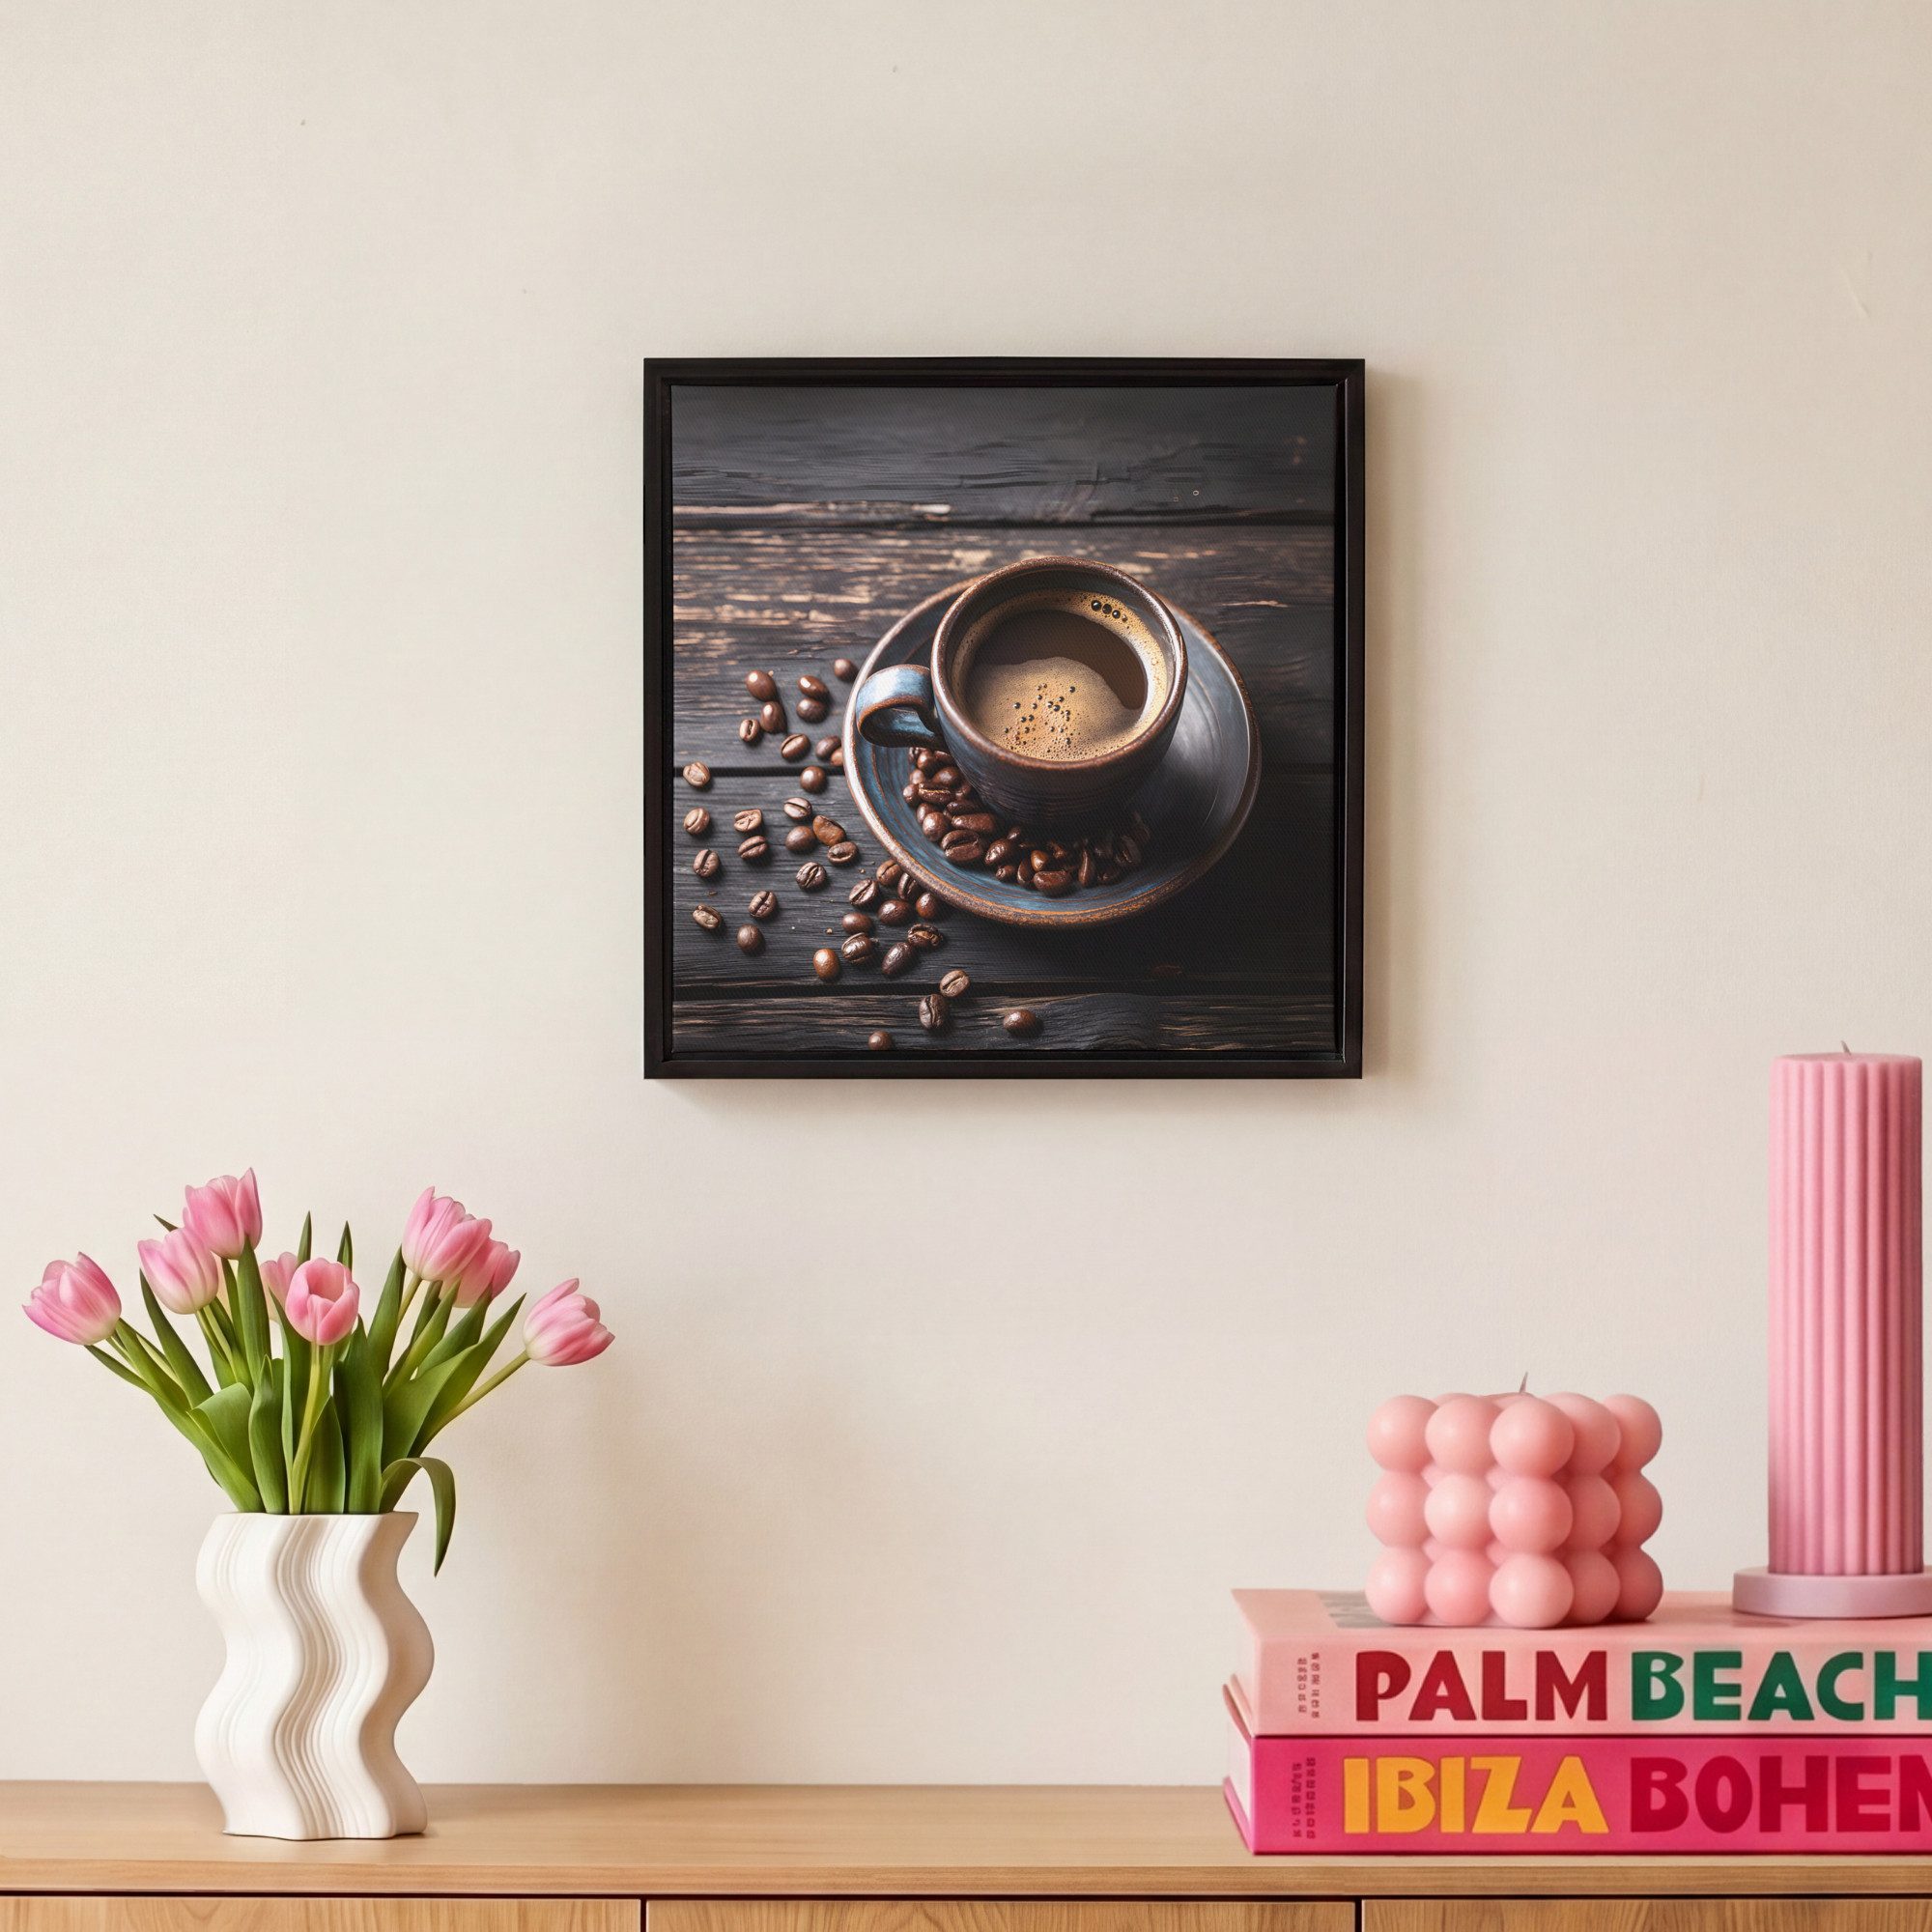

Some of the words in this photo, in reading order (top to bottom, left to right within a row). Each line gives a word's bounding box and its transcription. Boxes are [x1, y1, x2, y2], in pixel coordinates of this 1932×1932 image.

[1355, 1650, 1607, 1721] PALM
[1631, 1651, 1932, 1720] BEACH
[1343, 1756, 1609, 1834] IBIZA
